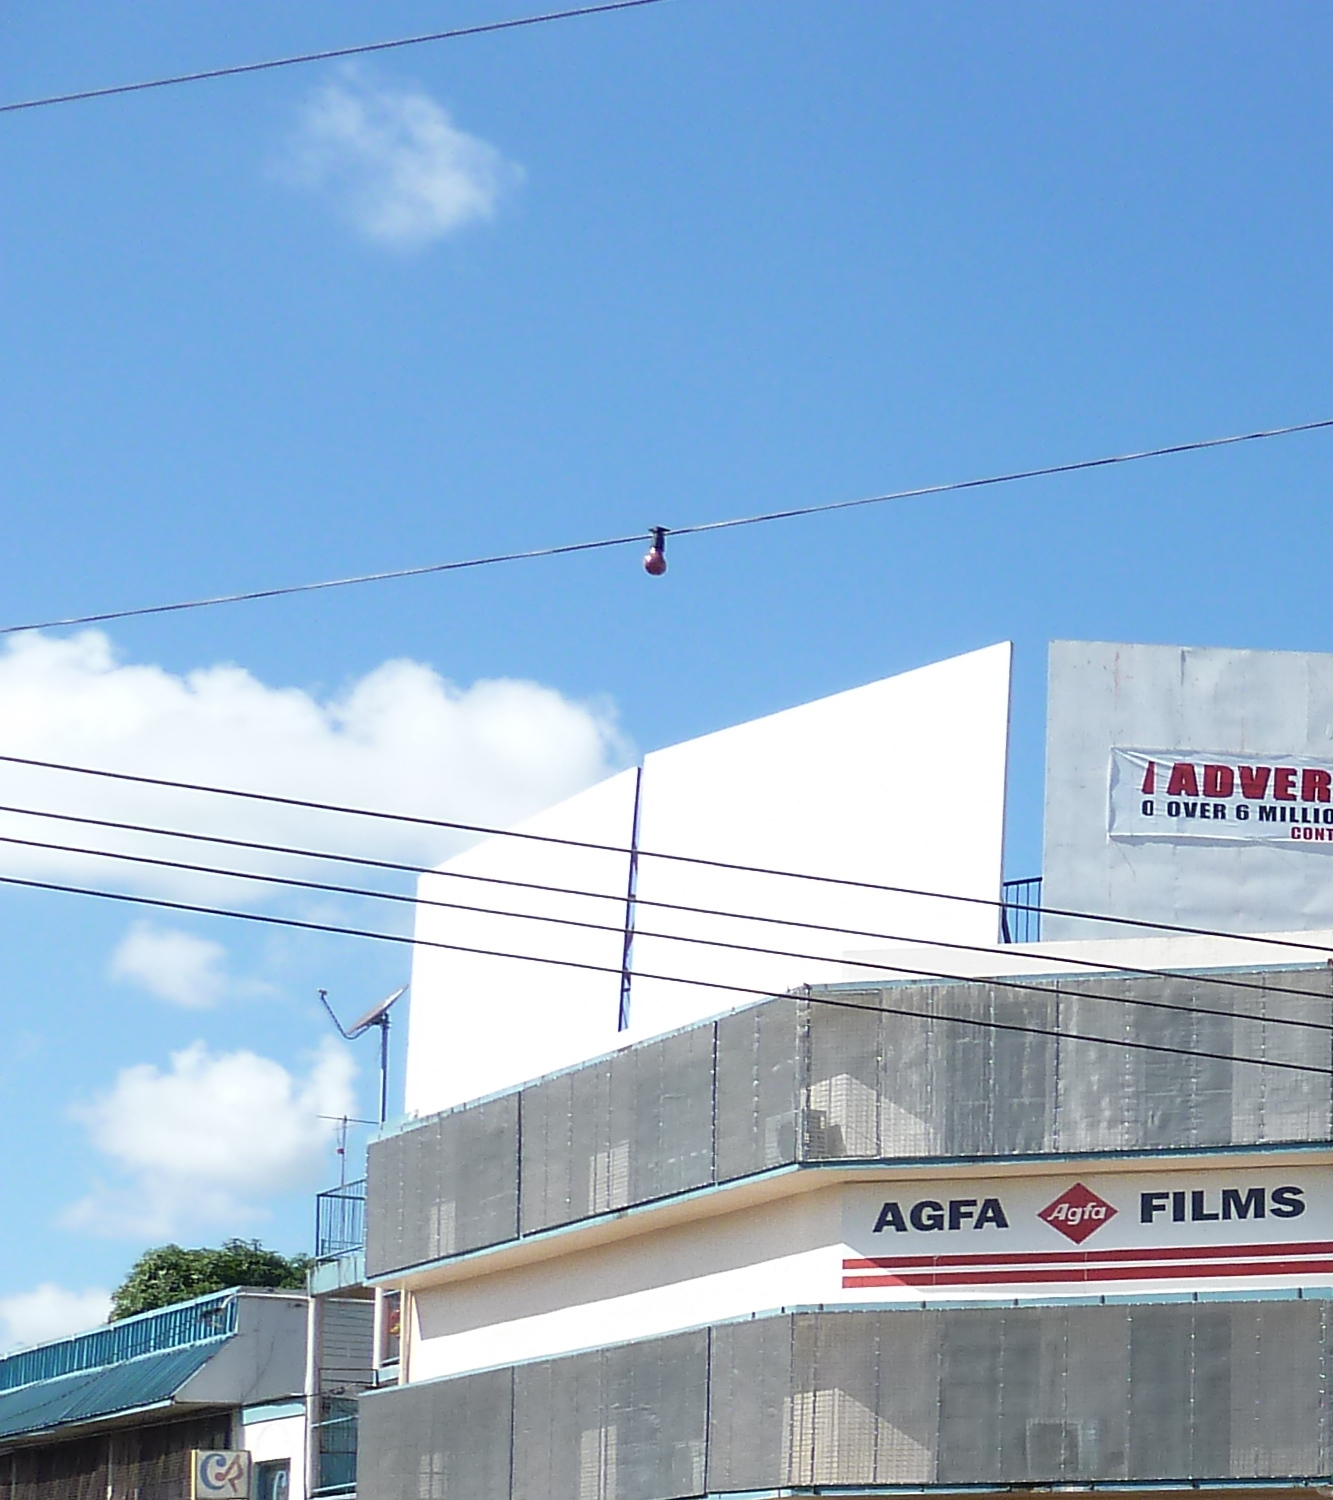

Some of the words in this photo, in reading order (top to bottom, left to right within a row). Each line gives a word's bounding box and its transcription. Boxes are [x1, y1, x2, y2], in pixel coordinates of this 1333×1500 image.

[1167, 801, 1227, 819] OVER
[1235, 804, 1250, 821] 6
[872, 1198, 1008, 1233] AGFA
[1140, 1185, 1306, 1223] FILMS
[1047, 1201, 1106, 1226] Agfa
